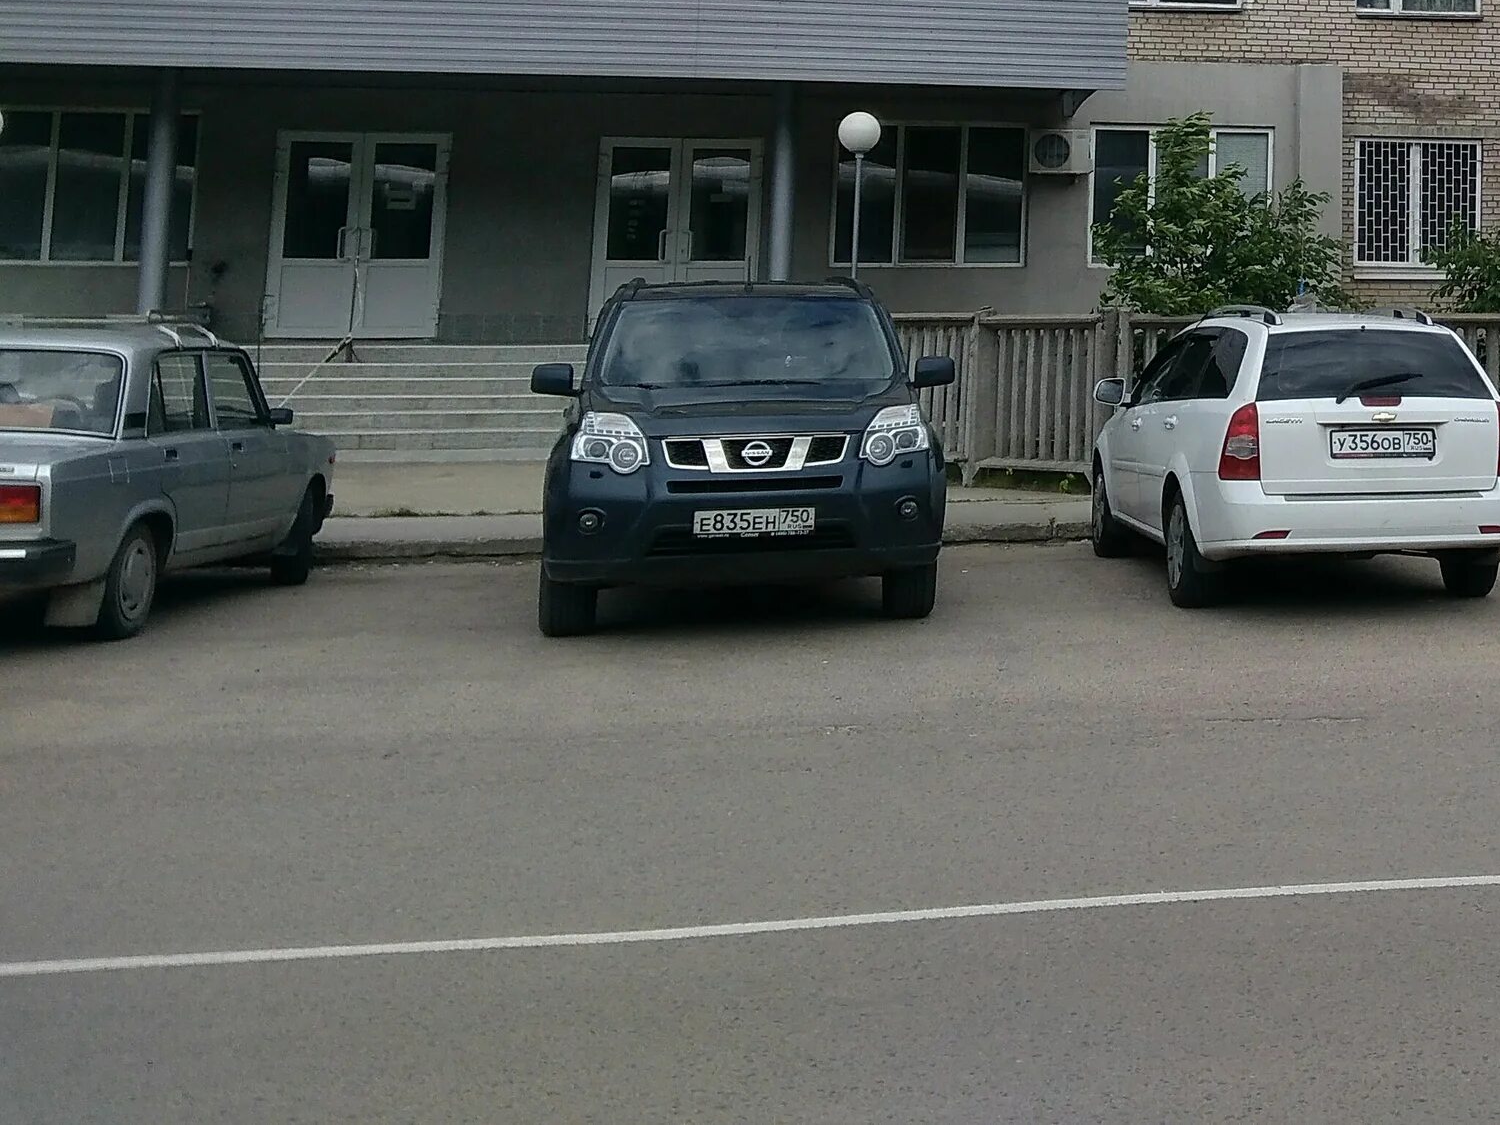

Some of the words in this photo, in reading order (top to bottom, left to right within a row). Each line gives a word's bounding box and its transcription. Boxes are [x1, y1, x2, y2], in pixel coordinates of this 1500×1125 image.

[1405, 432, 1429, 445] 750
[700, 513, 777, 532] Е835ЕН
[781, 510, 810, 523] 750
